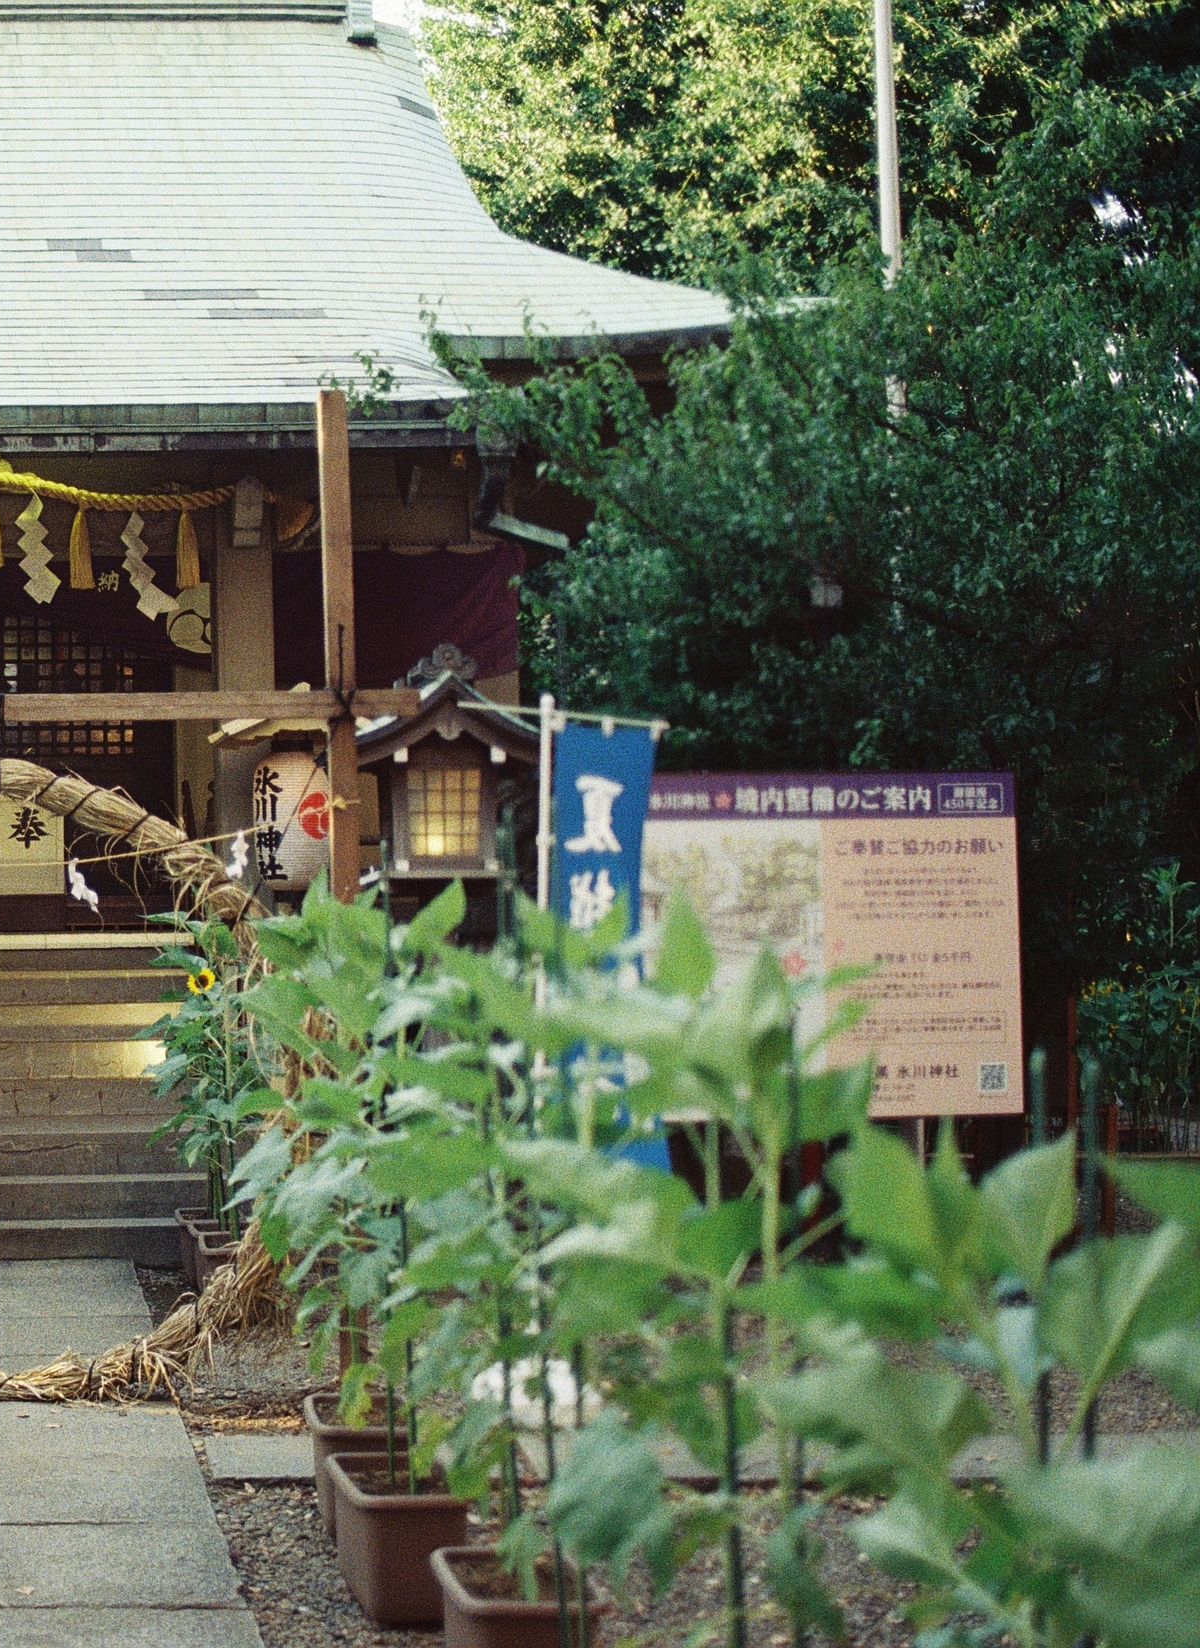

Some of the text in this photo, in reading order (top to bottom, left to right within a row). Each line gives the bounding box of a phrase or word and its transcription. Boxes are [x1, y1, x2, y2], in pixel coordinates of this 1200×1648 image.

[98, 569, 120, 593] 納
[735, 786, 932, 813] 境内整備のご案内
[8, 806, 49, 849] 奉
[254, 766, 288, 881] 氷川神社
[835, 838, 1003, 856] ご奉賛ご協力のお願い
[898, 1063, 959, 1079] 氷川神社
